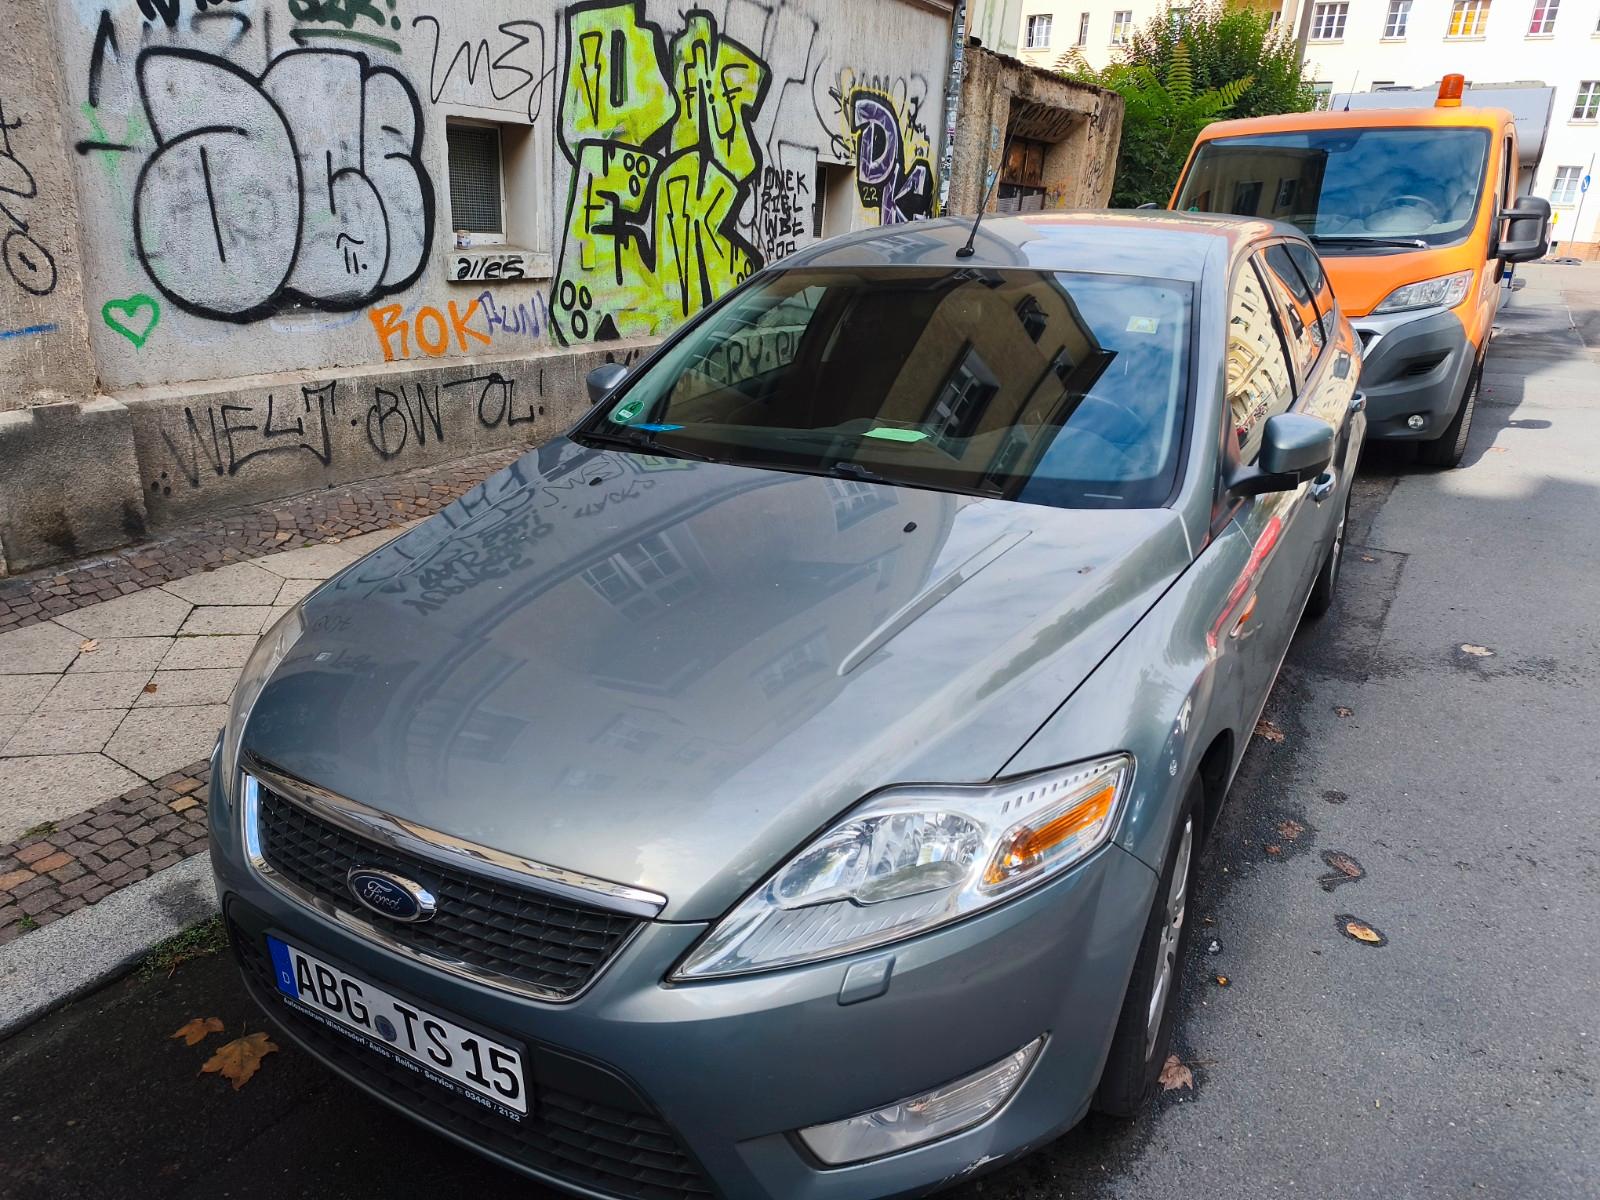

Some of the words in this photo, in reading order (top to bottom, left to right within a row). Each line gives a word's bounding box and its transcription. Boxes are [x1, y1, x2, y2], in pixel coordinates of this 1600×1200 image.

[458, 257, 525, 280] alles
[368, 299, 492, 362] ROK
[364, 880, 402, 911] Ford
[282, 971, 291, 985] D
[296, 954, 371, 1029] ABG
[393, 1002, 453, 1068] TS
[461, 1038, 520, 1099] 15
[424, 1070, 454, 1090] Service
